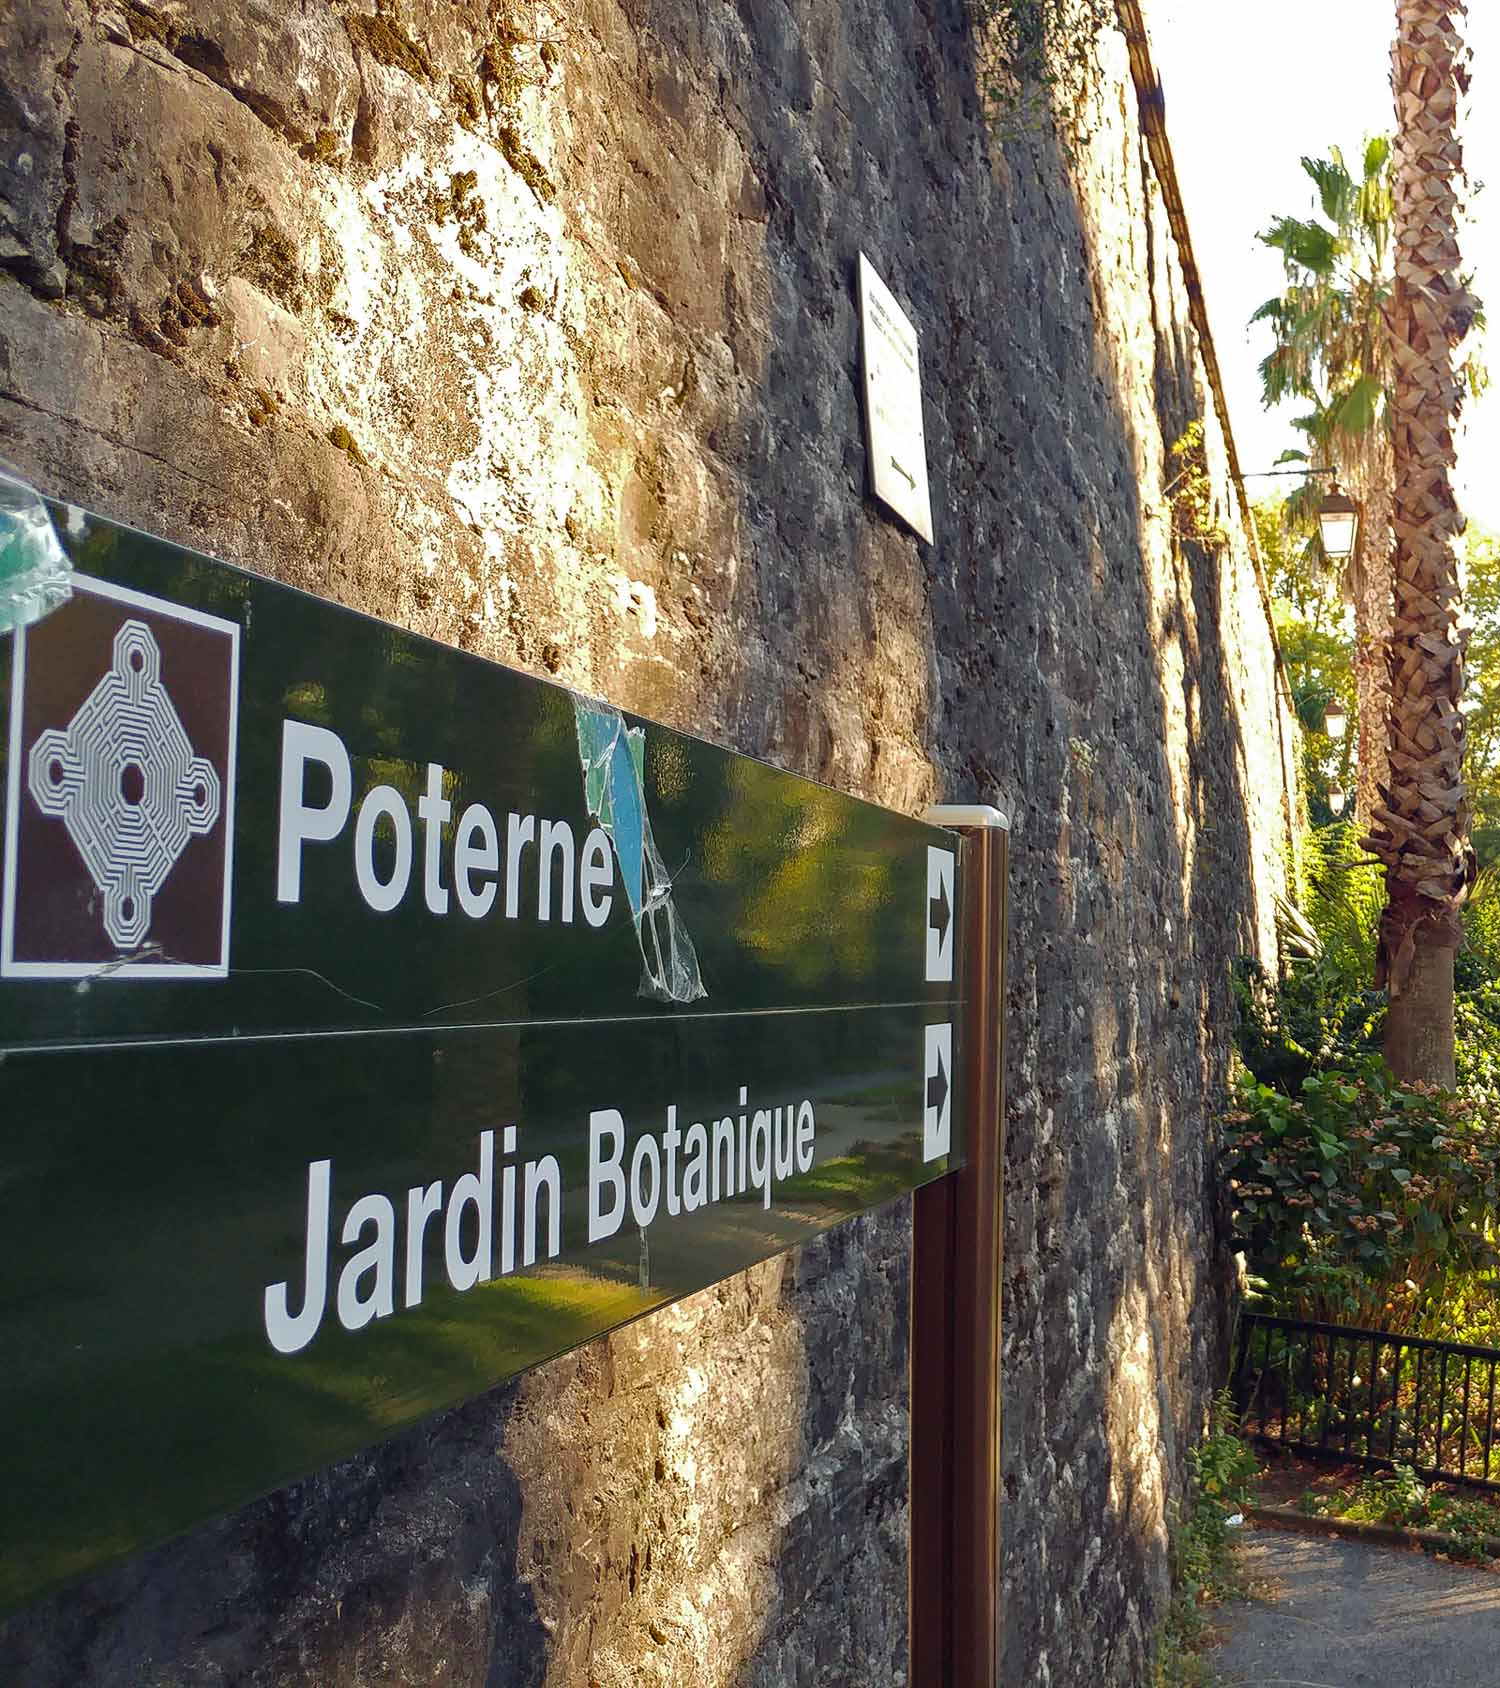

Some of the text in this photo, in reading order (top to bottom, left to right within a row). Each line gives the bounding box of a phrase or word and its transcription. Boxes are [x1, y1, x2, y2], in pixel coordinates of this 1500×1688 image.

[277, 719, 614, 927] Poterne
[264, 1086, 815, 1353] Jardin Botanique
